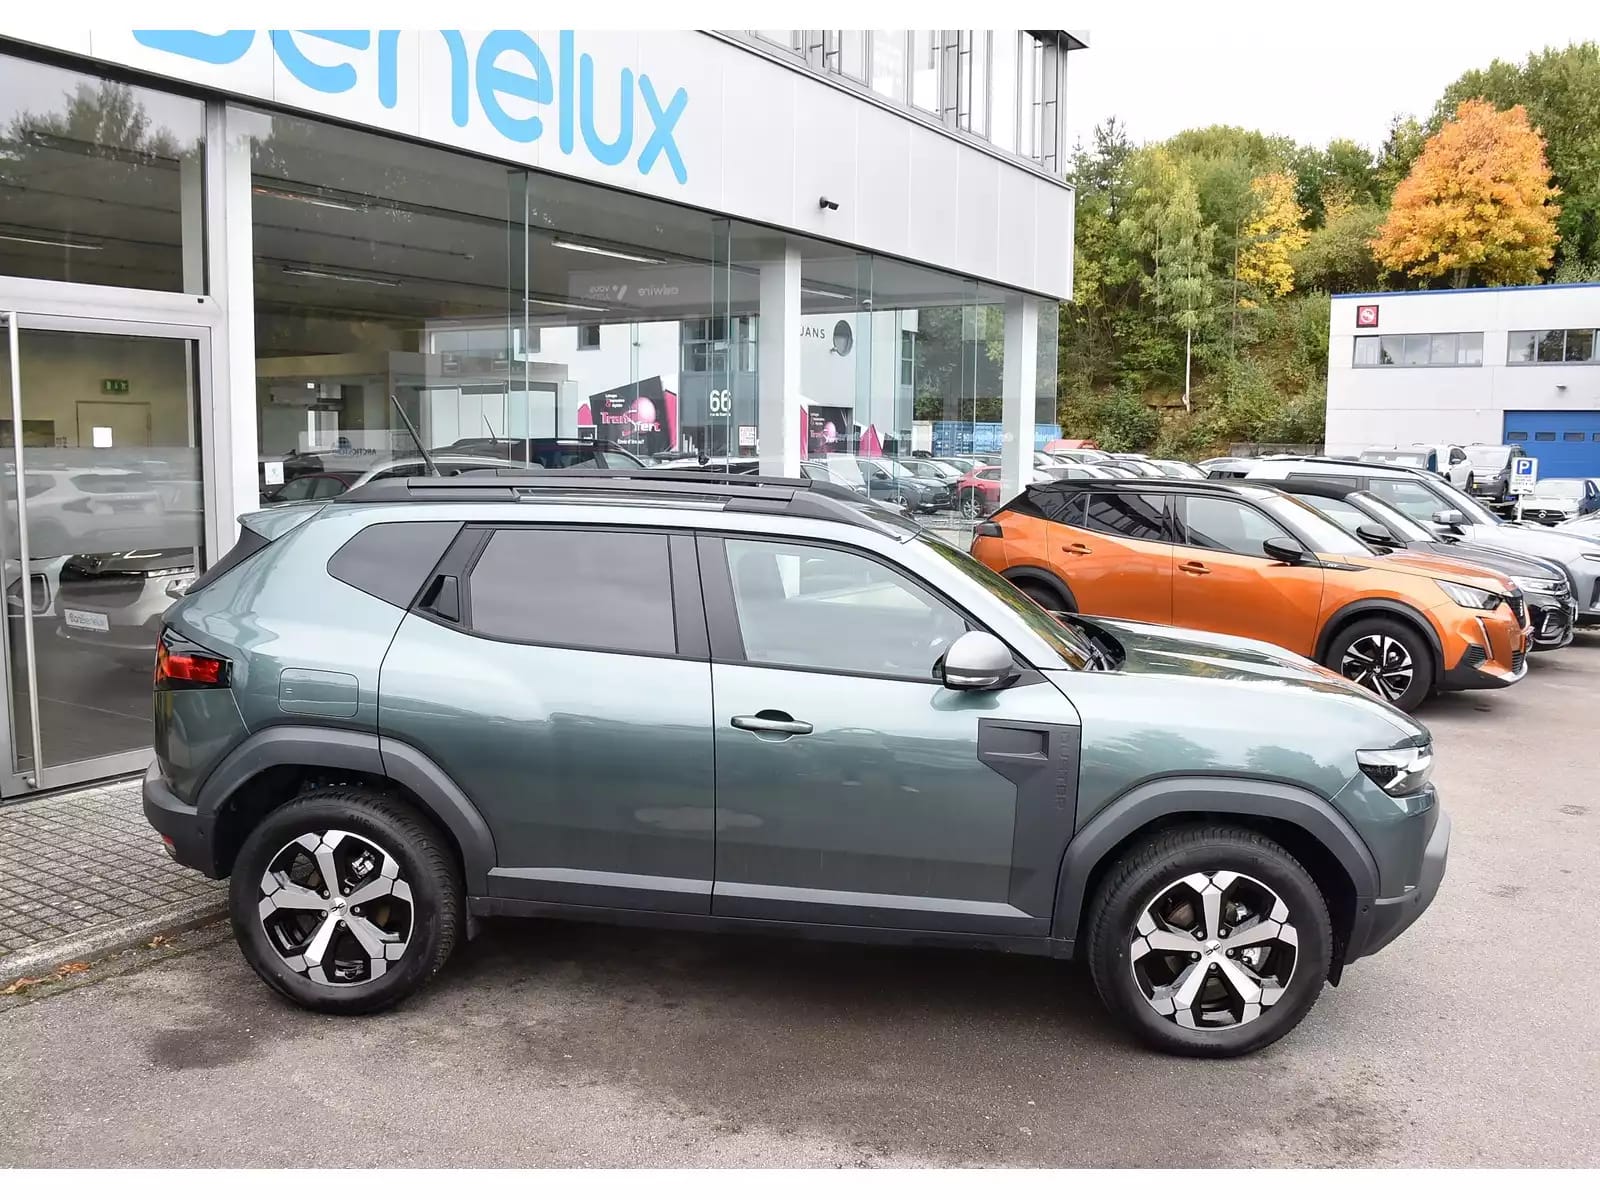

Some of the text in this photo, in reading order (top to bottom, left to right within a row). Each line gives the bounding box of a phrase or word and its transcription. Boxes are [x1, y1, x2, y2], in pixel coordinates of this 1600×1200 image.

[132, 30, 688, 185] enelux
[710, 389, 731, 412] 66
[1518, 461, 1530, 474] P
